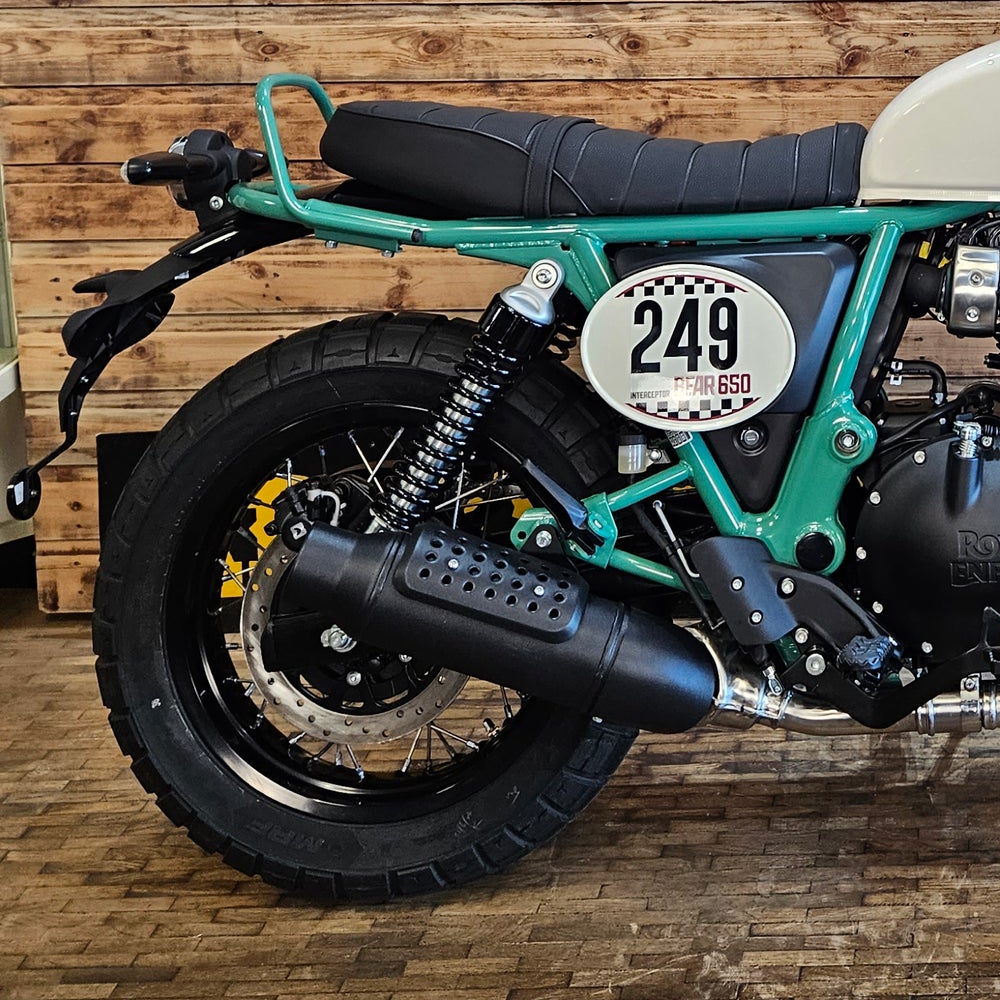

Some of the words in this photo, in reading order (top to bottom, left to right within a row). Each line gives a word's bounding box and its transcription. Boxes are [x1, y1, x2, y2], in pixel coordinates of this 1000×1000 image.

[630, 297, 738, 375] 249
[630, 390, 671, 400] INTERCEPTOR
[717, 373, 751, 395] 650
